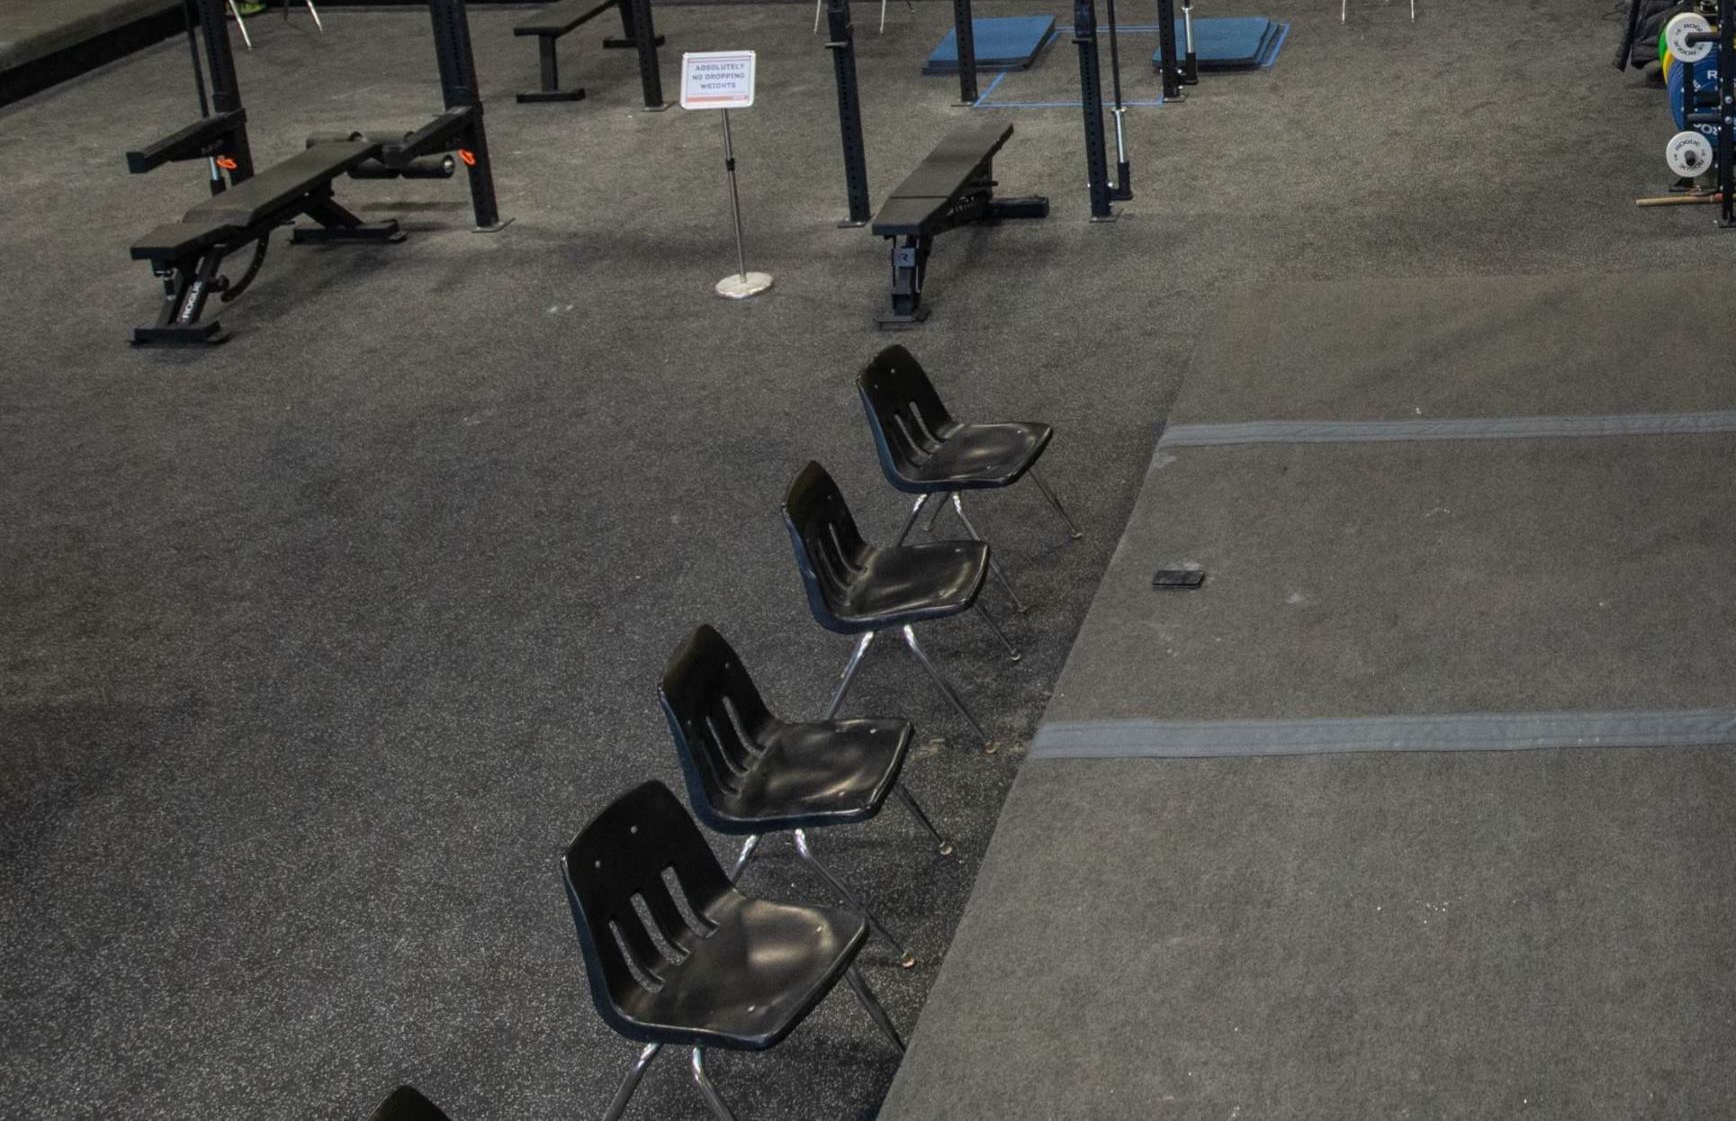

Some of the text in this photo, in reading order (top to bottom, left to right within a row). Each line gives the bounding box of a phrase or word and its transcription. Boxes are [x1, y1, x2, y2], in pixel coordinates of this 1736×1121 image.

[695, 63, 745, 72] ABSOLUTELY
[705, 72, 745, 80] DROPPING
[182, 281, 202, 319] ROGUE
